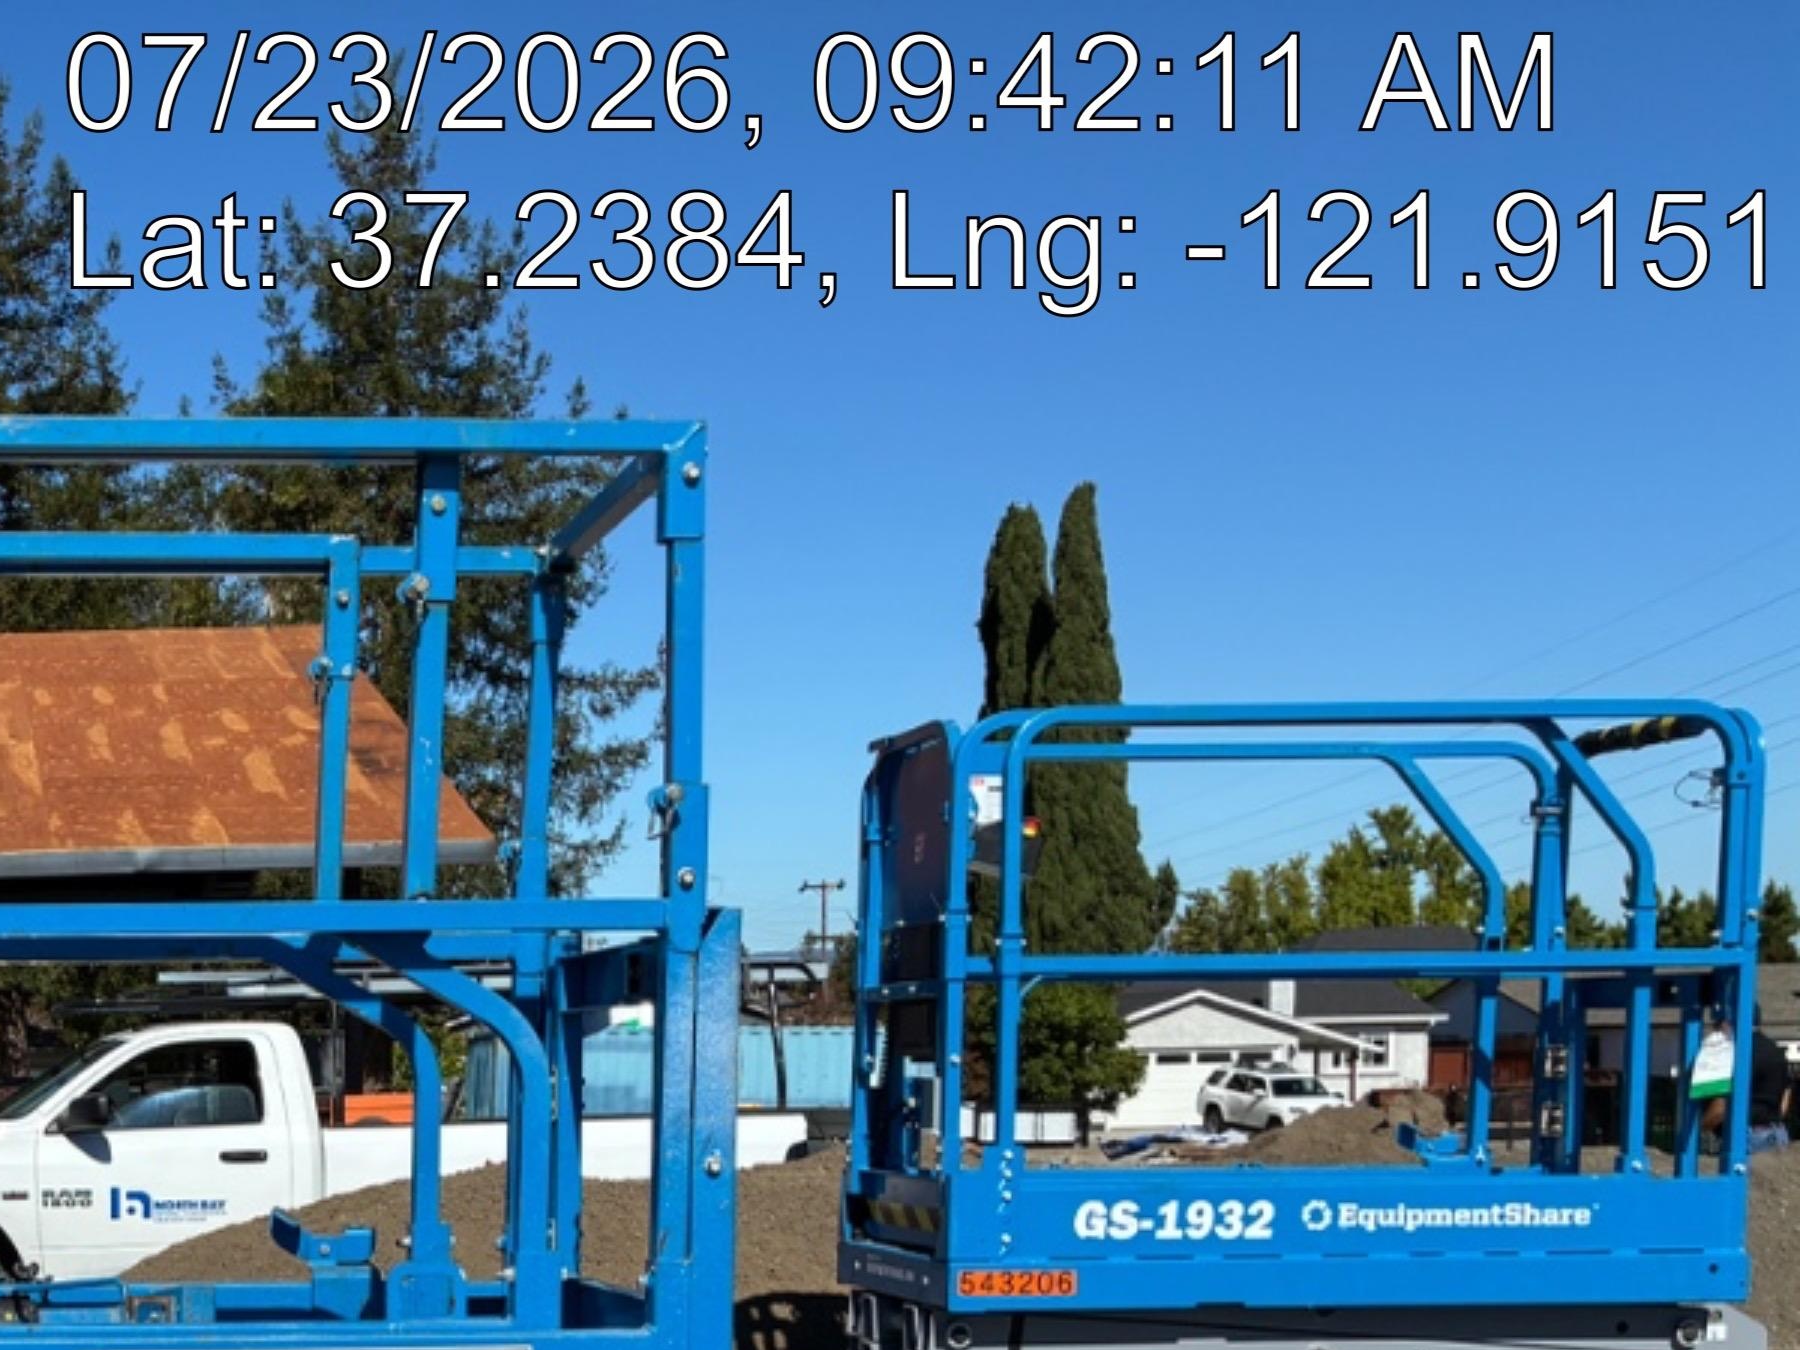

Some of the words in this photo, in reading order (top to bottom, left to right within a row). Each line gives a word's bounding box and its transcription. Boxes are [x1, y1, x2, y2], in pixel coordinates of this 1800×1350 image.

[1073, 1199, 1275, 1241] GS-1932
[1338, 1202, 1591, 1232] EquipmentShare
[960, 1270, 1073, 1295] 543206
